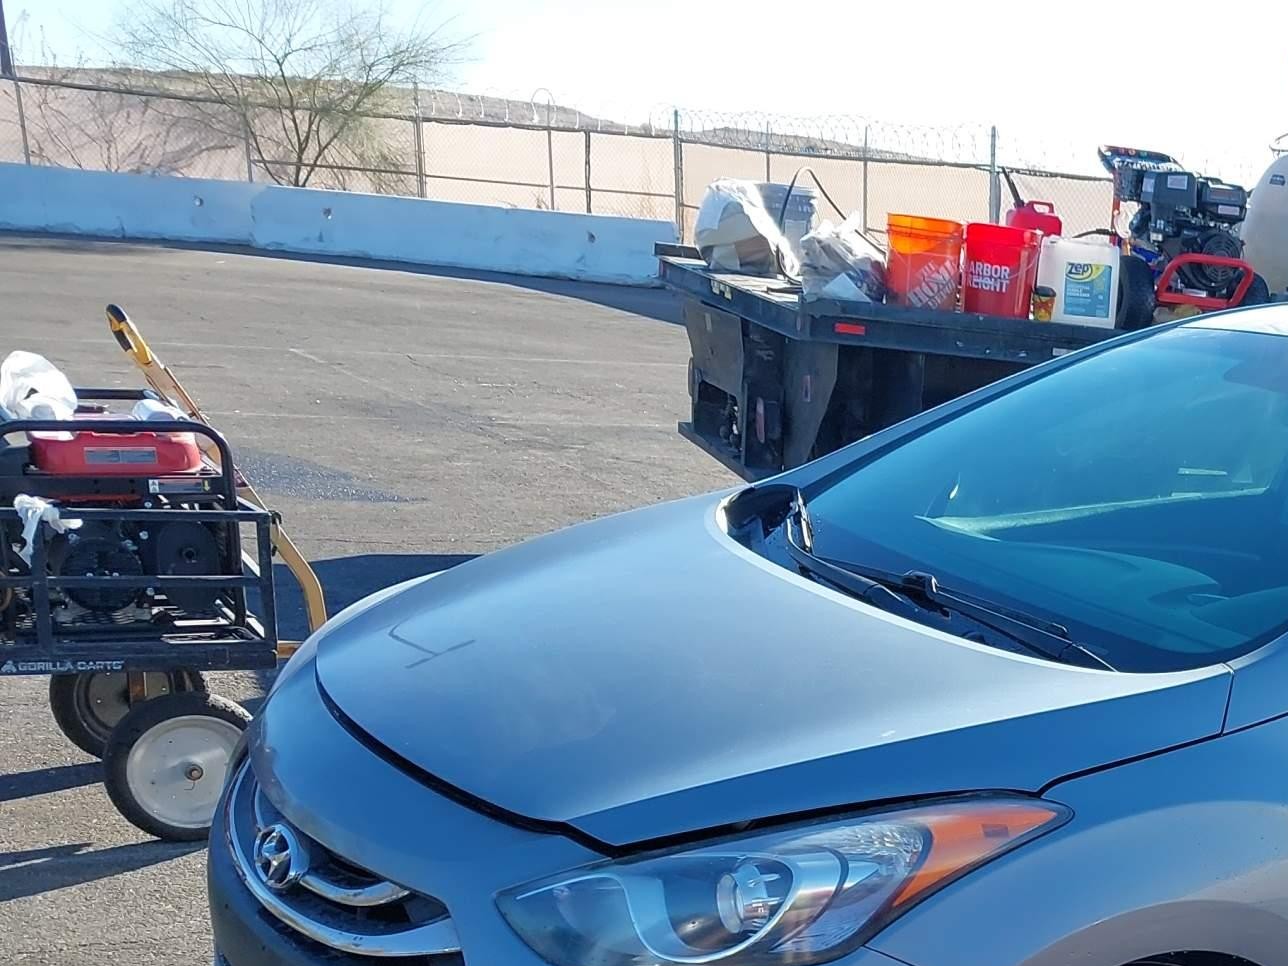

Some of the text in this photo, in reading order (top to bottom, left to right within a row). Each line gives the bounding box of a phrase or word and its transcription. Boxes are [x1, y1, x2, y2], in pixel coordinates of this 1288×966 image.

[969, 261, 1010, 279] ARBOR
[18, 660, 124, 672] GORILLA CARTS
